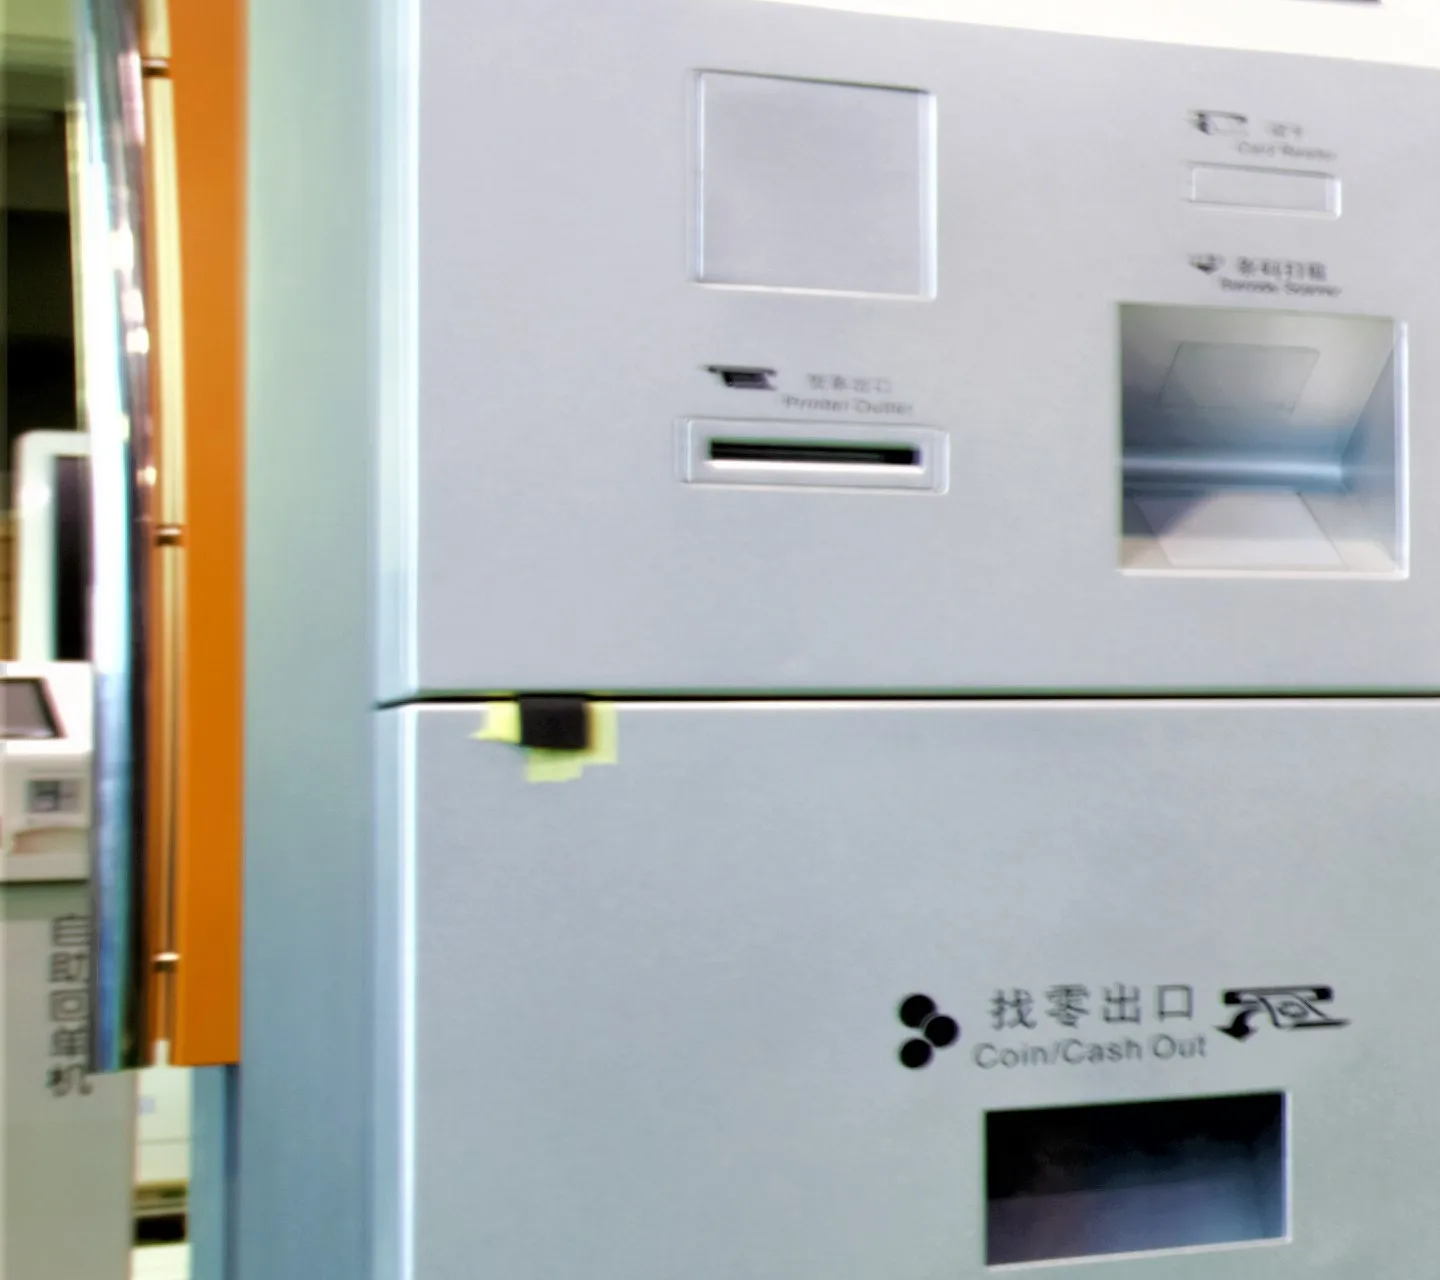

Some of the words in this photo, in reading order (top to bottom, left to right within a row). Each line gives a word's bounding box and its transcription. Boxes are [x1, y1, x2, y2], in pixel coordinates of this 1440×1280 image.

[988, 982, 1195, 1031] 找零出口
[975, 1037, 1143, 1071] Coin/Cash
[1152, 1033, 1208, 1061] Out
